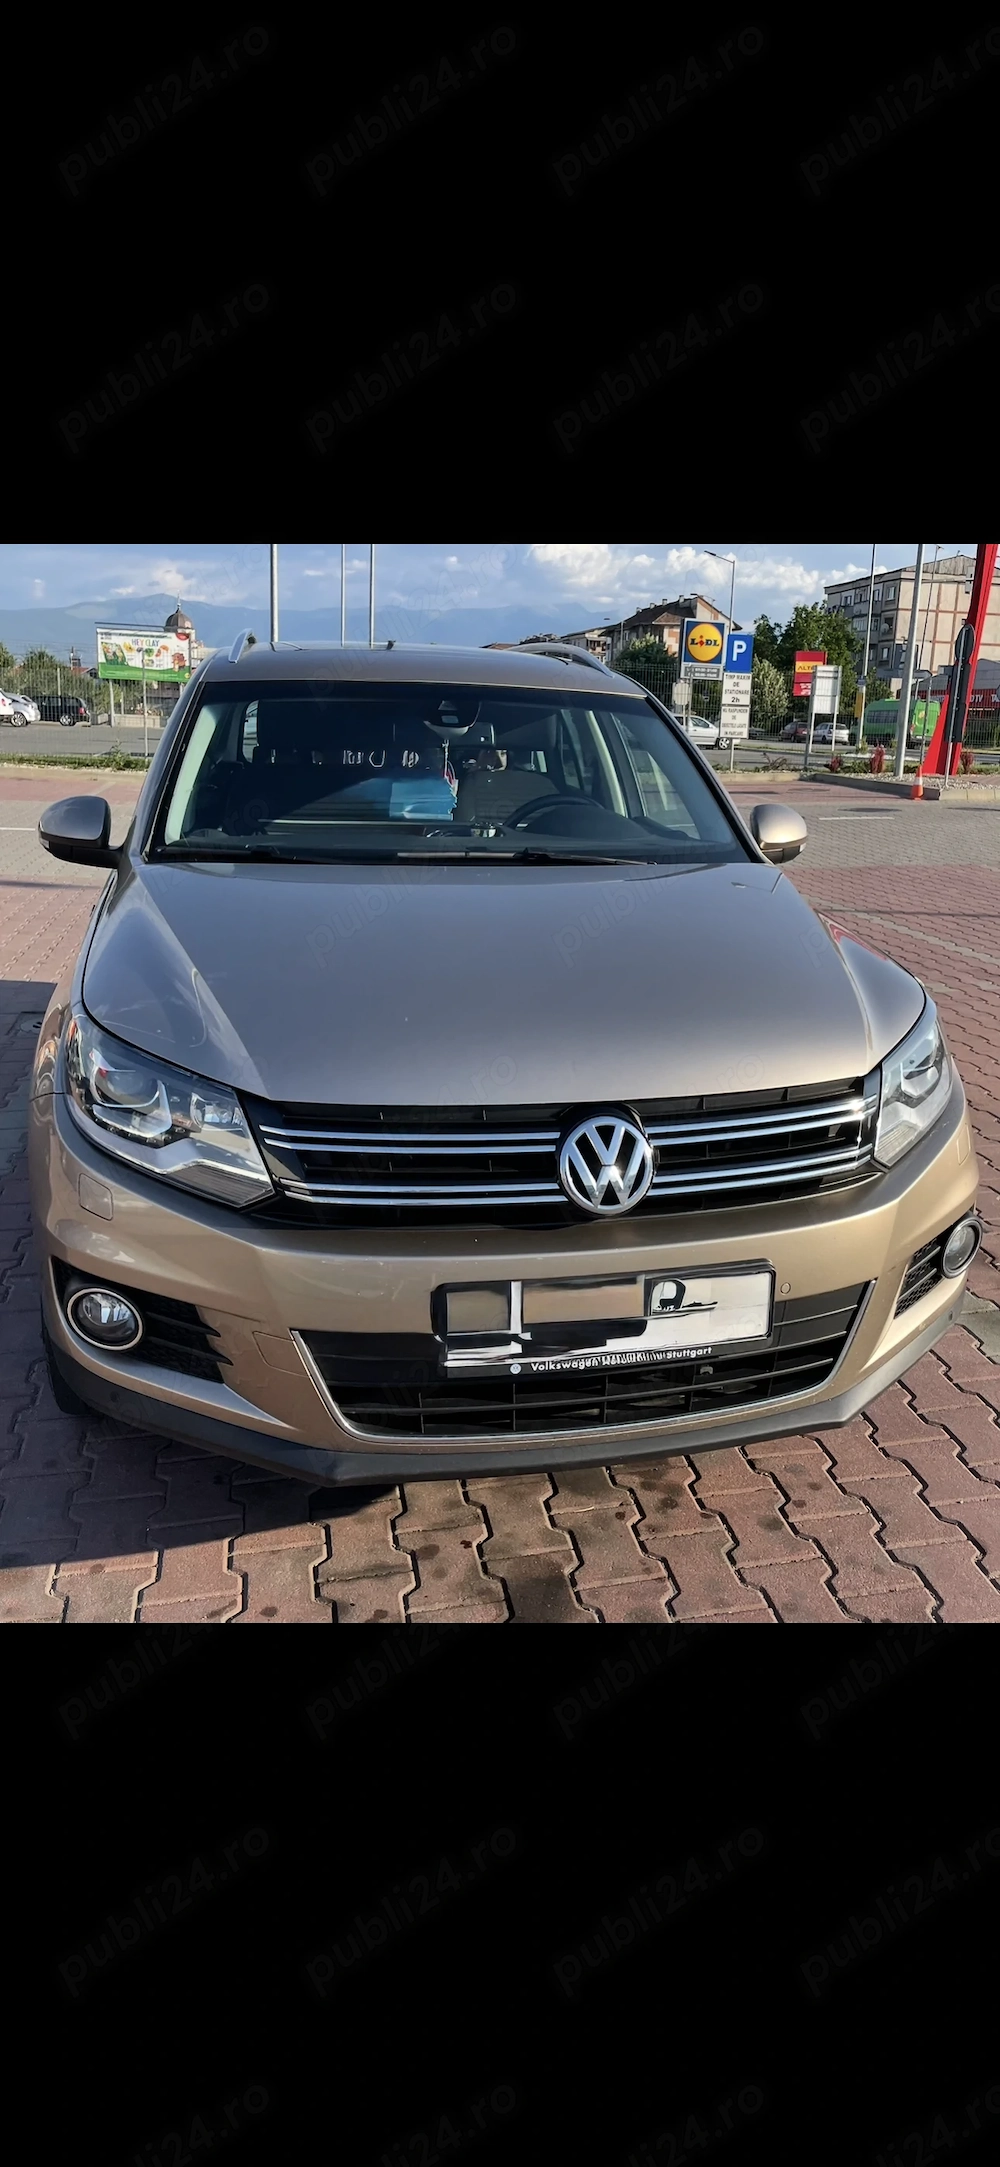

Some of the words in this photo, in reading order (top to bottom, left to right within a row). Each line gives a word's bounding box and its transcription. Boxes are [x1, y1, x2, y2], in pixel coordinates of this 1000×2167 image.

[145, 639, 160, 647] CLAY
[732, 640, 747, 661] P
[666, 1346, 713, 1360] Stuttgart
